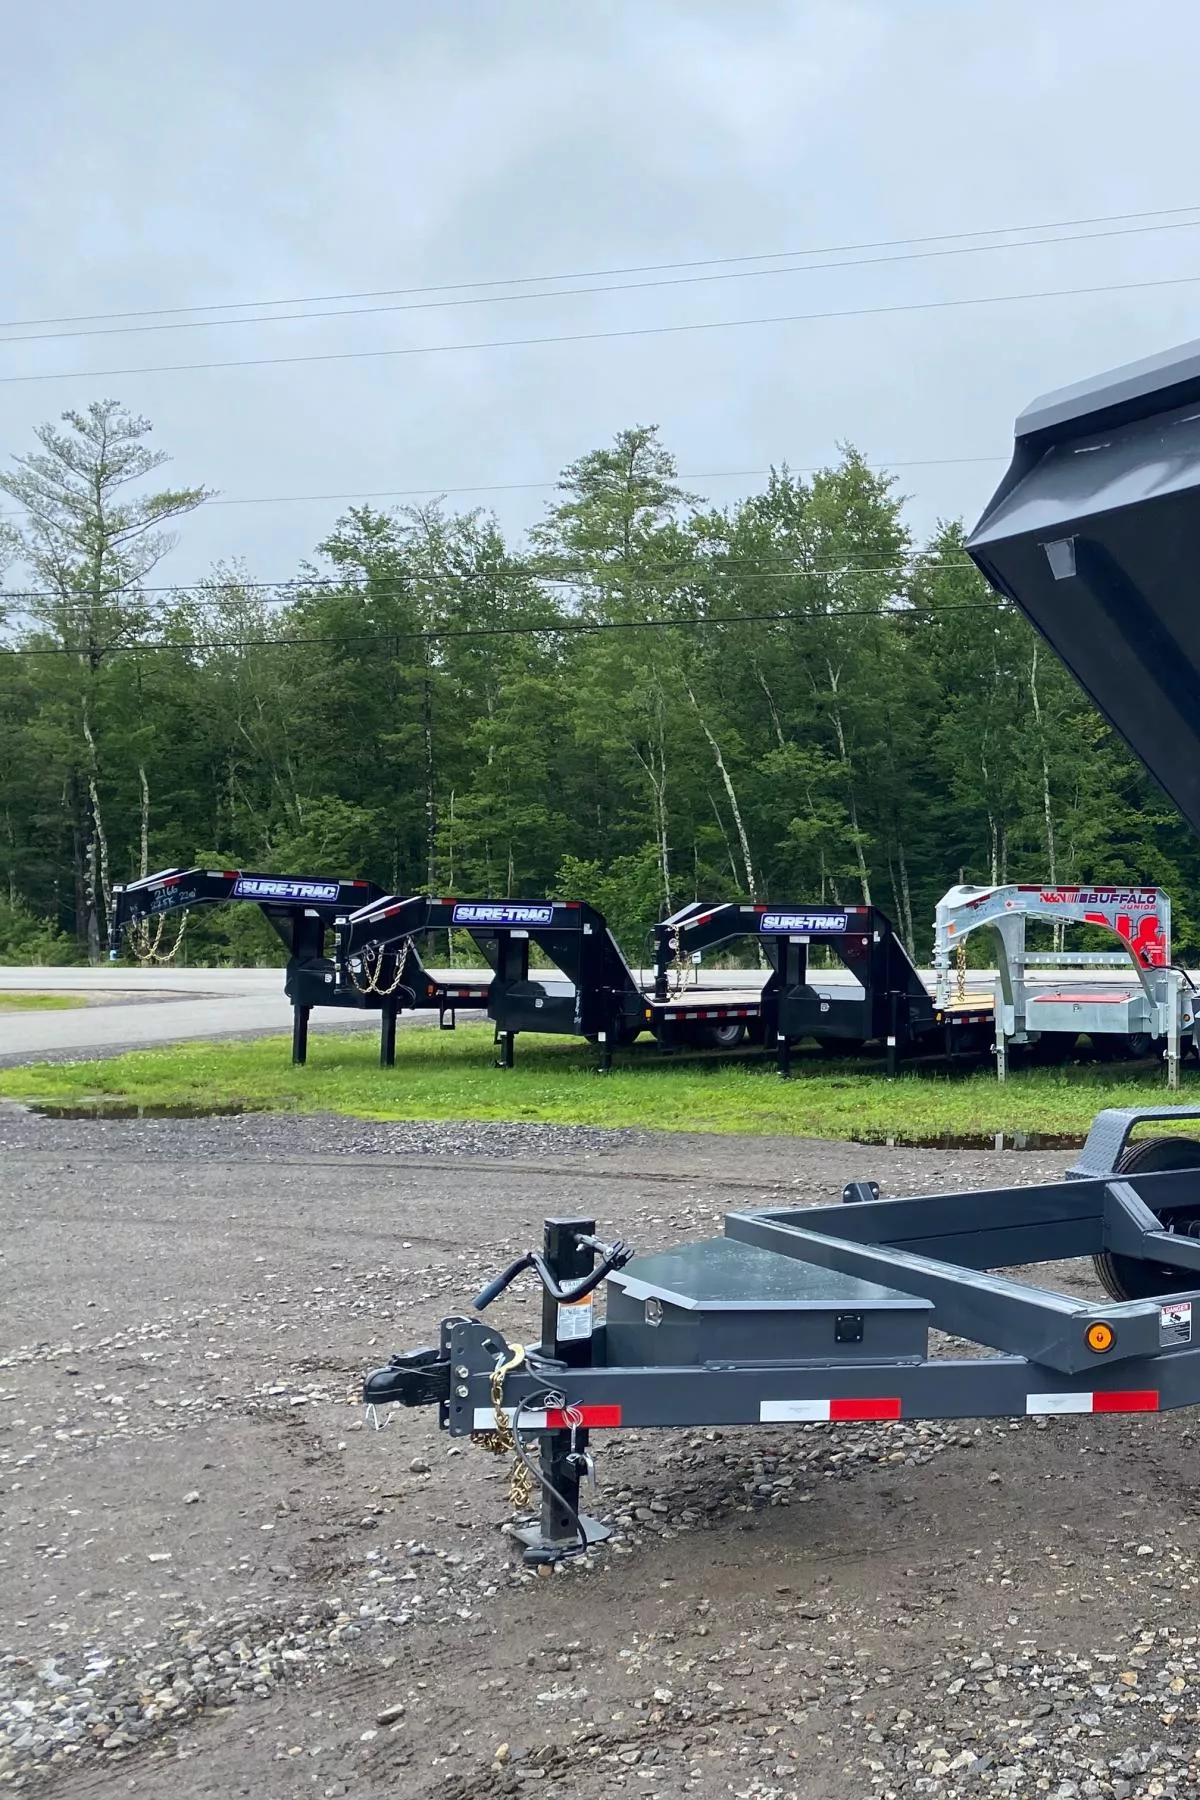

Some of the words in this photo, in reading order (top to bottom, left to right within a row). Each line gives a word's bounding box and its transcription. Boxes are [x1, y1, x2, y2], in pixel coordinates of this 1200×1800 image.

[238, 881, 336, 899] SURE-TRAC
[1088, 893, 1157, 904] BUFFALO
[456, 907, 550, 922] SURE-TRAC
[763, 916, 844, 930] SURE-TRAC
